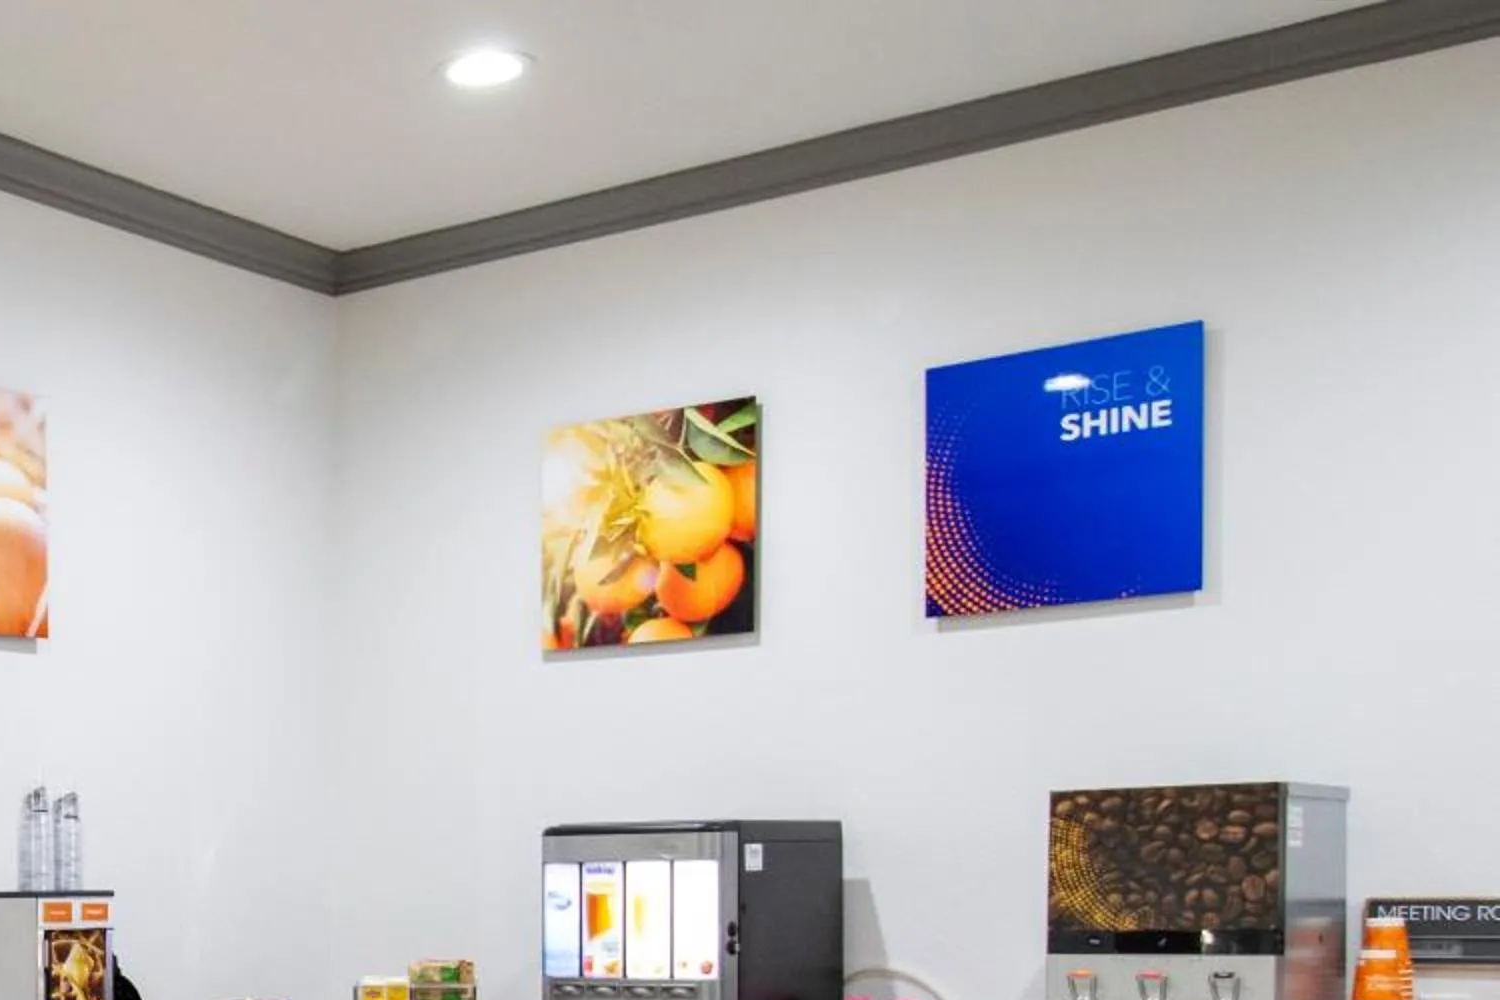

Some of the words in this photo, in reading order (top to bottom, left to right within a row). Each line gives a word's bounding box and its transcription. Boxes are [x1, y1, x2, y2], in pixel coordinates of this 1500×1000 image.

[1061, 369, 1134, 410] RISE
[1145, 365, 1171, 397] &
[1059, 399, 1173, 441] SHINE
[1377, 904, 1472, 921] MEETING
